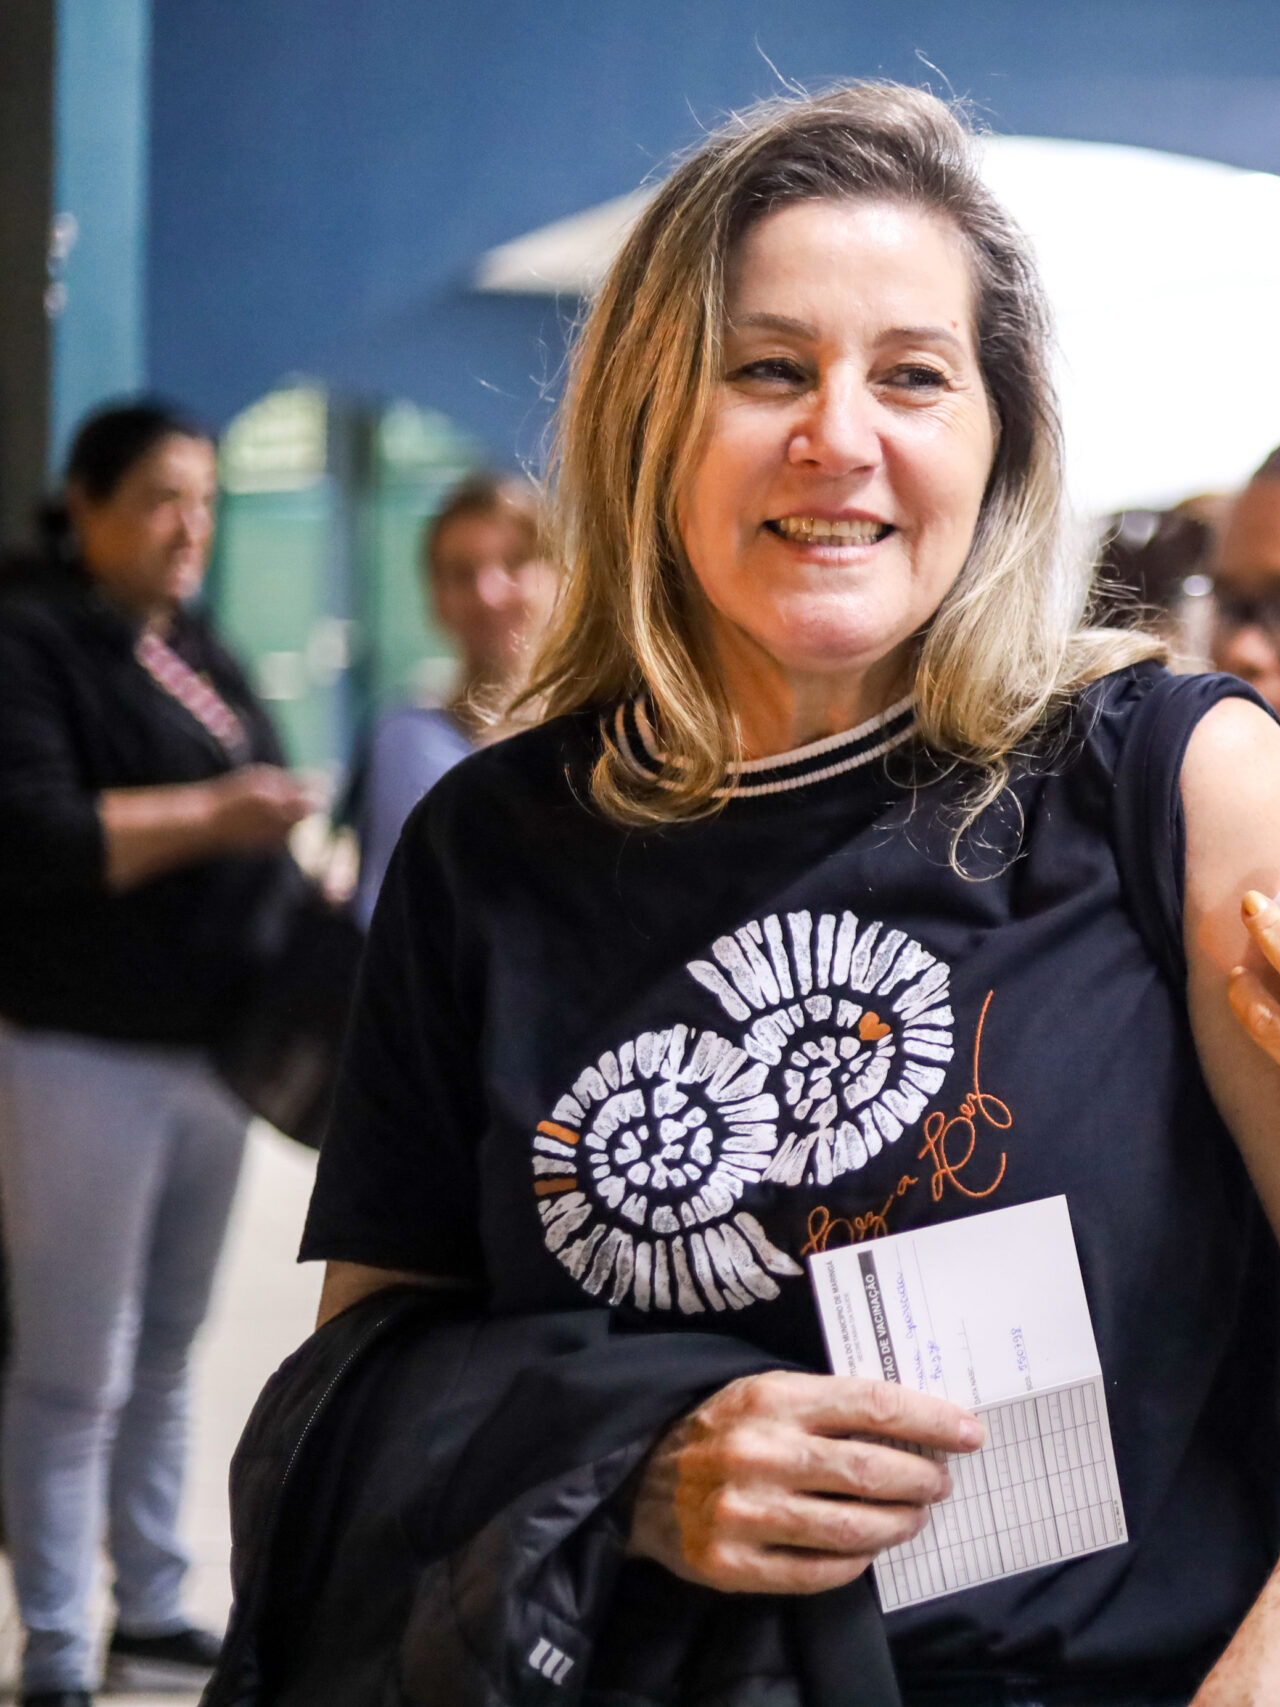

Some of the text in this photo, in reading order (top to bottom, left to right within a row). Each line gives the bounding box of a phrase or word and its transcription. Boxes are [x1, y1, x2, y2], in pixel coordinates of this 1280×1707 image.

[833, 1294, 841, 1304] DE
[864, 1273, 898, 1384] RTÃO DE VACINAÇÃO
[844, 1342, 852, 1353] DO
